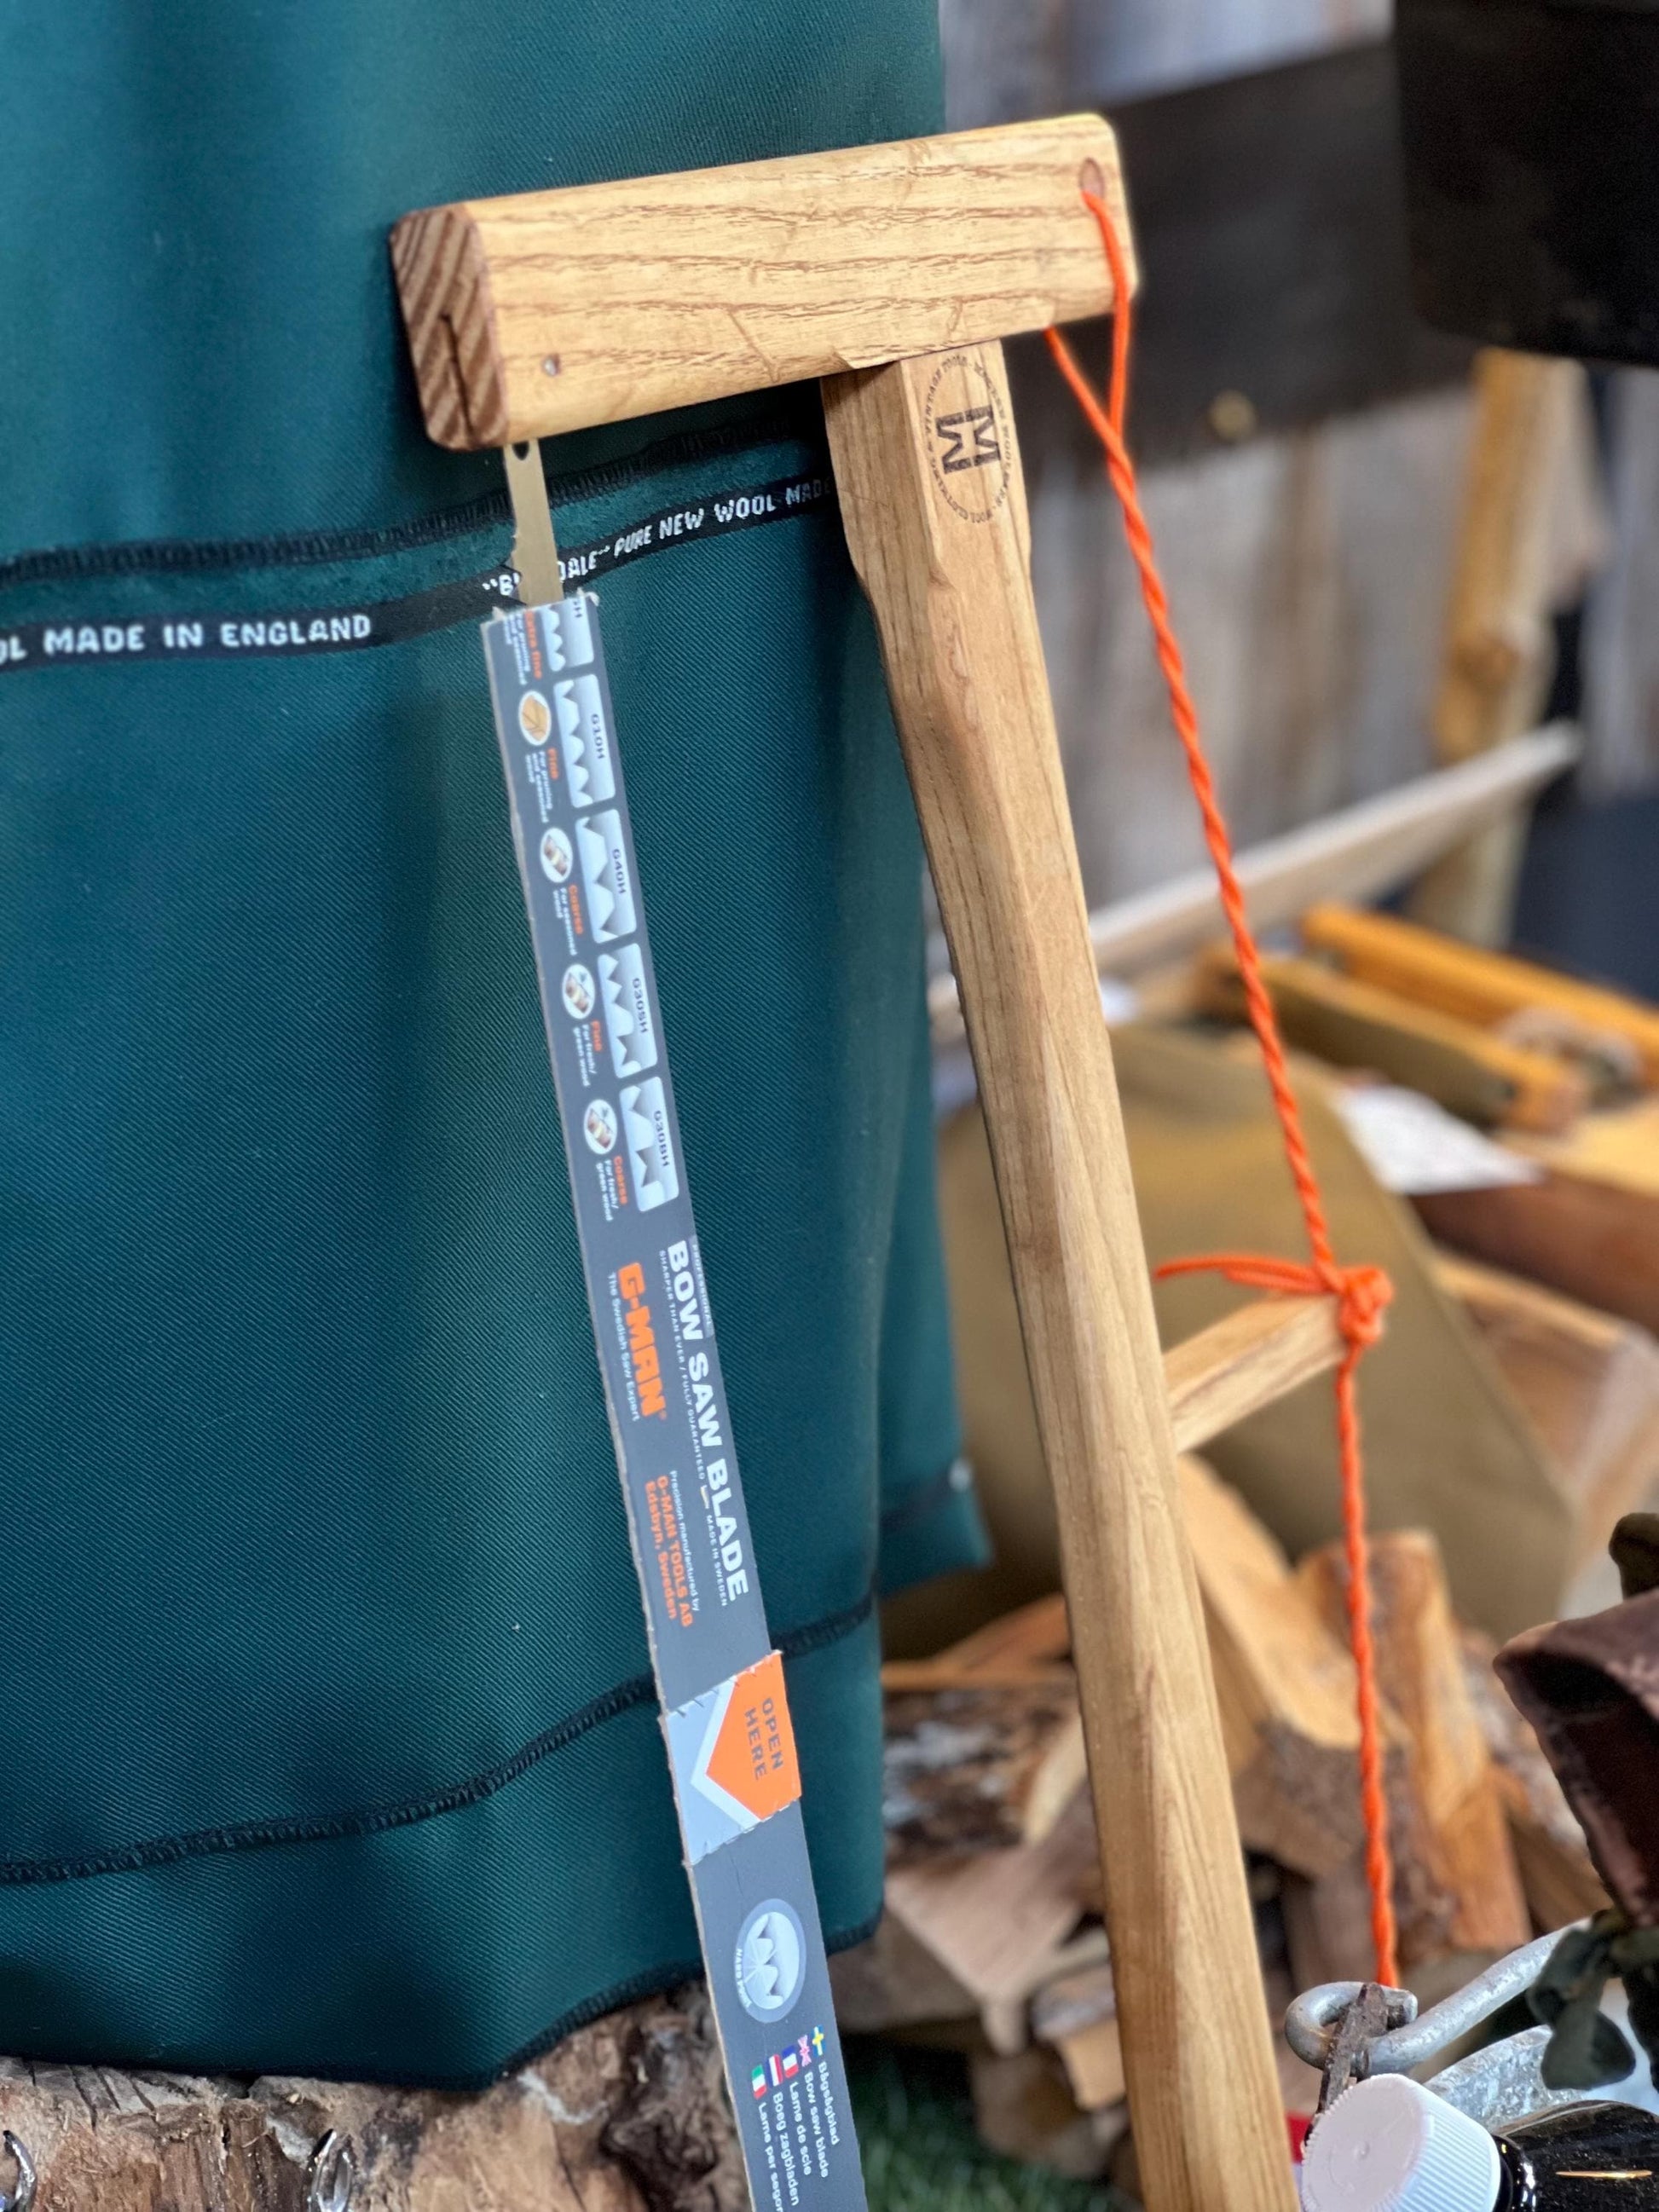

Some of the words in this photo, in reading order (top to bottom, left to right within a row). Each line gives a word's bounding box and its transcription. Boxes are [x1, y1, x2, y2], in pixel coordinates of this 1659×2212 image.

[925, 368, 943, 435] VINTAGE
[614, 525, 653, 558] PURE
[659, 507, 705, 540] NEW
[714, 494, 777, 523] WOOL
[43, 624, 146, 655] MADE
[163, 622, 204, 649] IN
[220, 614, 372, 648] ENGLAND
[609, 1273, 617, 1296] The
[692, 1245, 711, 1325] PROFESSIONAL
[612, 1298, 627, 1349] Swedish
[618, 1262, 666, 1417] G-MAN
[621, 1353, 631, 1377] Saw
[660, 1250, 673, 1300] SHARPER
[669, 1303, 679, 1331] THAN
[675, 1336, 685, 1363] EVER
[682, 1374, 691, 1405] FULLY
[688, 1409, 705, 1479] GUARANTEED
[627, 1381, 639, 1421] Expert
[668, 1240, 702, 1340] BOW
[689, 1353, 722, 1447] SAW
[707, 1458, 749, 1601] BLADE
[656, 1476, 676, 1538] G-MAN
[707, 1515, 716, 1545] MADE
[645, 1481, 663, 1549] Edsbyn,
[658, 1551, 676, 1619] Sweden
[670, 1470, 684, 1520] Precision
[679, 1522, 697, 1596] manufactured
[692, 1598, 699, 1610] by
[671, 1540, 688, 1598] TOOLS
[713, 1548, 719, 1559] IN
[679, 1602, 693, 1626] AB
[714, 1562, 727, 1606] SWEDEN
[744, 1707, 767, 1780] HERE
[762, 1697, 783, 1770] OPEN
[789, 2082, 802, 2122] Lame
[805, 2071, 815, 2103] Bow
[811, 2106, 820, 2134] saw
[816, 2136, 829, 2177] blade
[818, 2061, 840, 2144] Bågsågblad
[759, 2102, 771, 2142] Lame
[765, 2146, 776, 2168] per
[797, 2125, 806, 2143] de
[801, 2146, 812, 2174] scie
[780, 2133, 799, 2205] zagbladen
